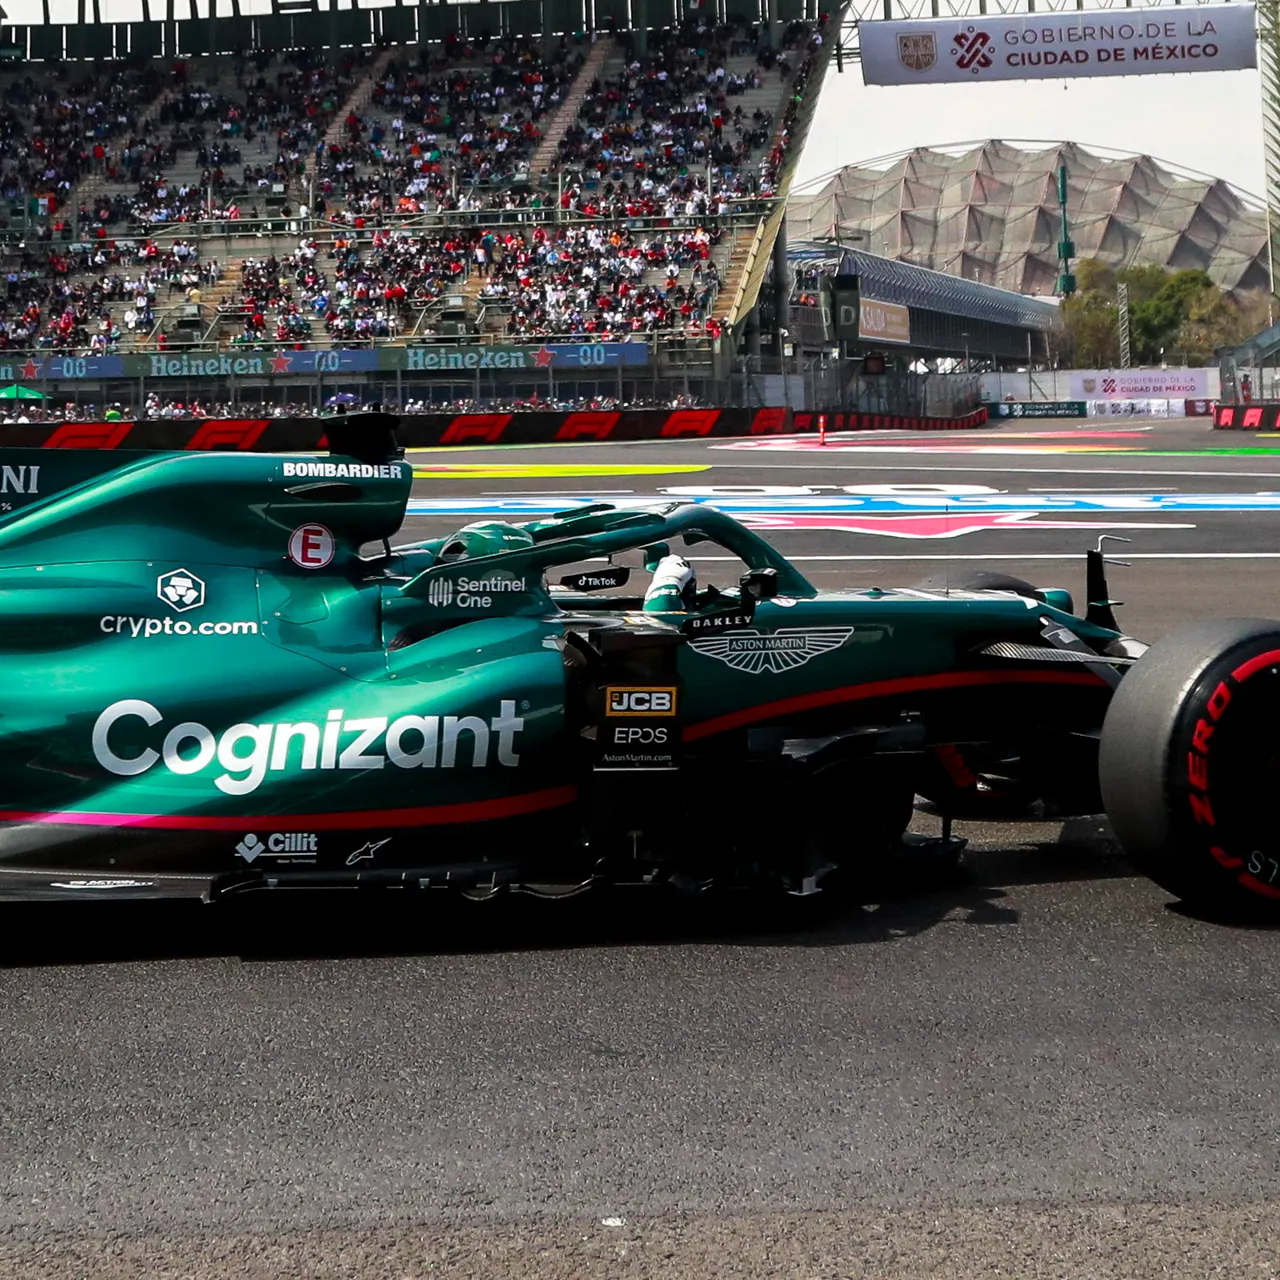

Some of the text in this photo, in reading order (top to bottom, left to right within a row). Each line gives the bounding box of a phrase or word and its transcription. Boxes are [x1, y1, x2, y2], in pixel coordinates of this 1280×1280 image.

[1004, 20, 1218, 46] GOBIERNO DE LA
[1006, 42, 1219, 67] CIUDAD DE MÉXICO
[149, 354, 264, 377] Heineken
[407, 348, 526, 370] Heineken
[282, 462, 403, 479] BOMBARDIER
[300, 528, 324, 564] E
[456, 577, 526, 594] Sentinel
[587, 576, 617, 586] TikTok
[456, 592, 492, 609] One
[99, 614, 259, 639] crypto.com
[692, 615, 752, 628] OAKLEY
[730, 637, 805, 651] ASTON MARTIN
[612, 692, 671, 711] JCB
[614, 727, 668, 744] EPOS
[91, 698, 524, 796] Cognizant
[602, 753, 672, 763] AstonMartin.com
[268, 833, 318, 852] Cillit
